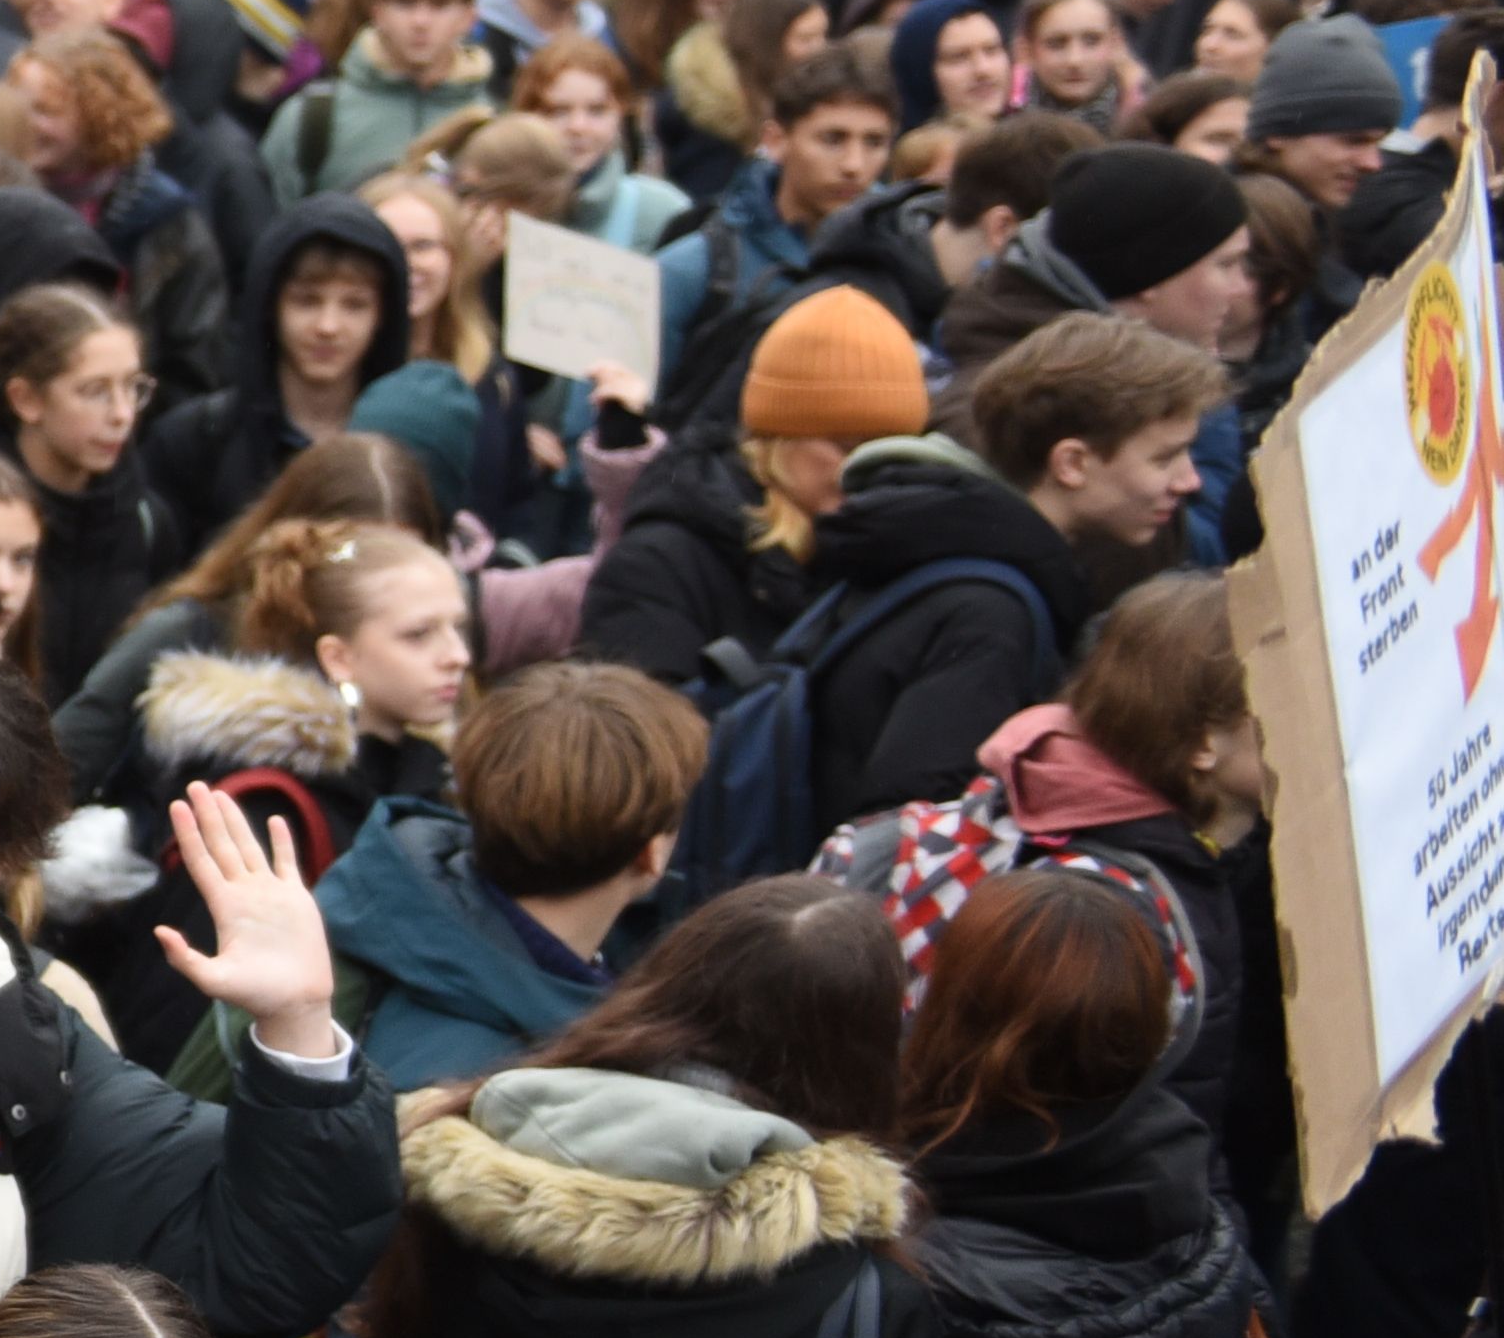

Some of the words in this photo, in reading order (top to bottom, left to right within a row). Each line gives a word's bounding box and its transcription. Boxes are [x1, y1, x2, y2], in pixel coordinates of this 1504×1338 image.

[1352, 537, 1374, 583] an
[1374, 517, 1403, 563] der
[1360, 562, 1407, 625] Front
[1358, 599, 1421, 675] sterben
[1428, 769, 1447, 810] 50
[1449, 722, 1492, 788] Jahre
[1414, 784, 1479, 878] arbeiten
[1427, 812, 1497, 917] Aussicht
